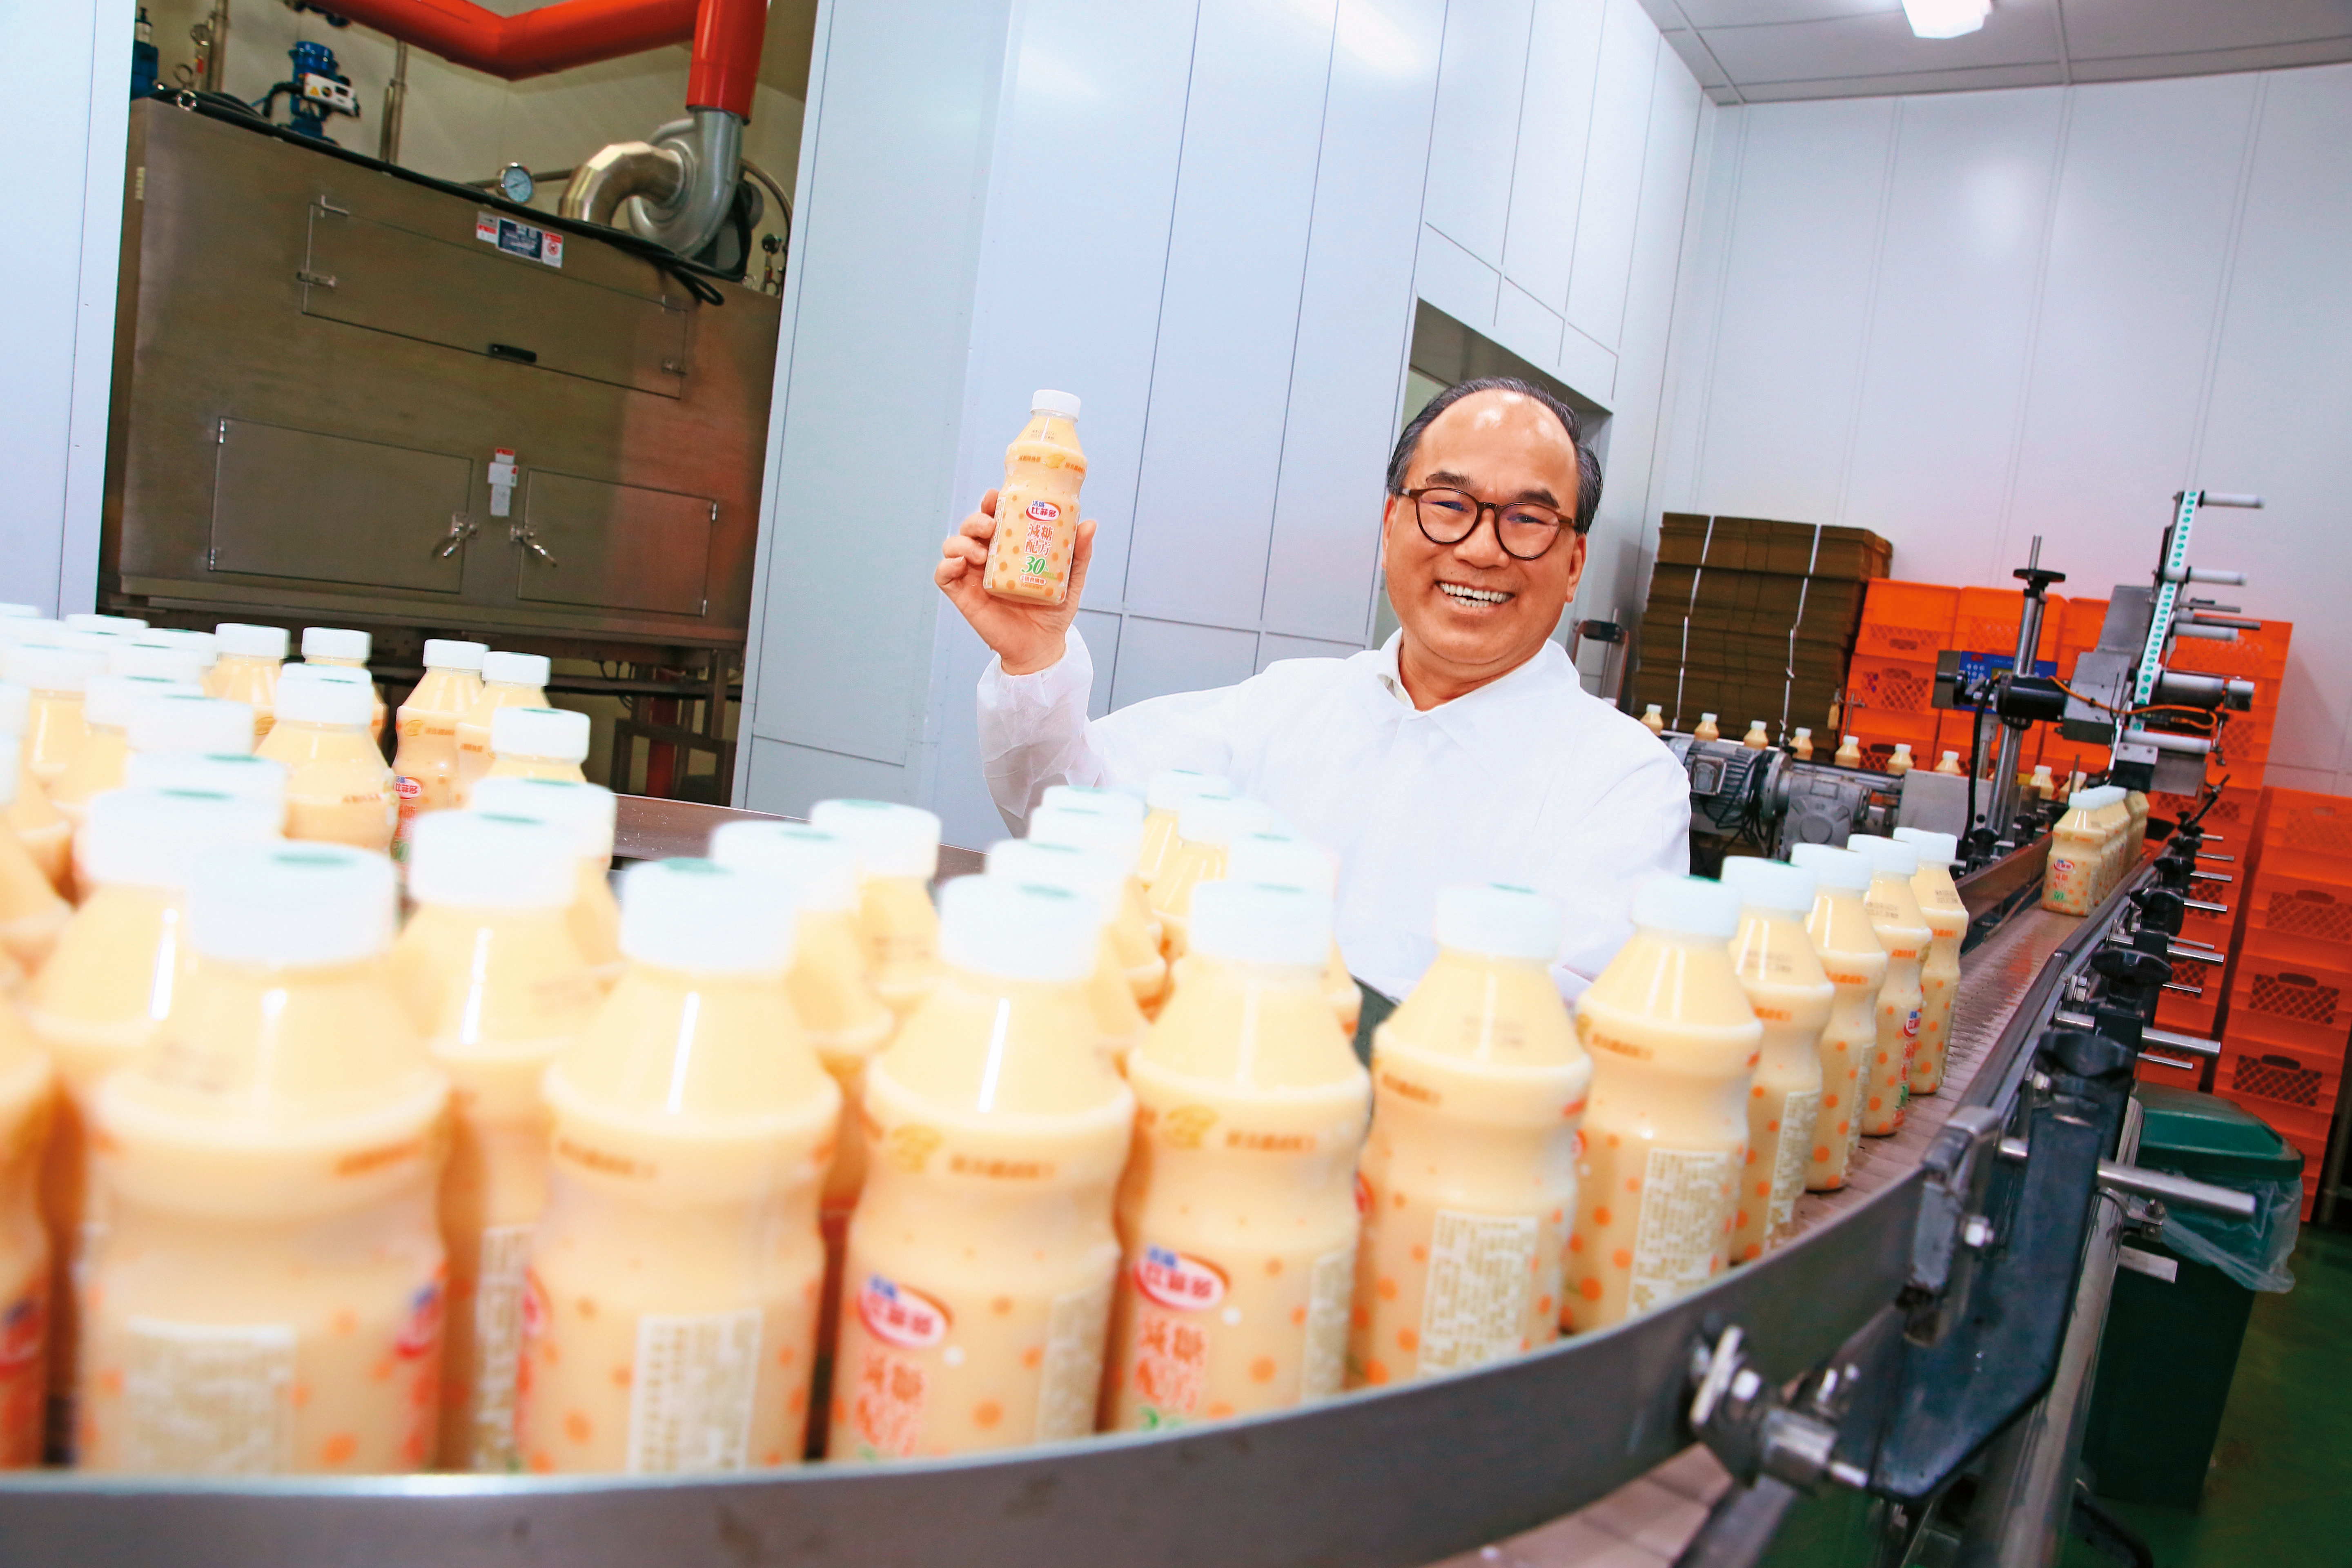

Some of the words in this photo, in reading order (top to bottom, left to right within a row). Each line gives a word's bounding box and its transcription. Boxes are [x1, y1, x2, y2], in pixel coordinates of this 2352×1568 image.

[1031, 506, 1056, 517] 比菲多
[1027, 523, 1053, 541] 減糖
[1025, 539, 1051, 557] 配方
[395, 782, 418, 794] 比菲多
